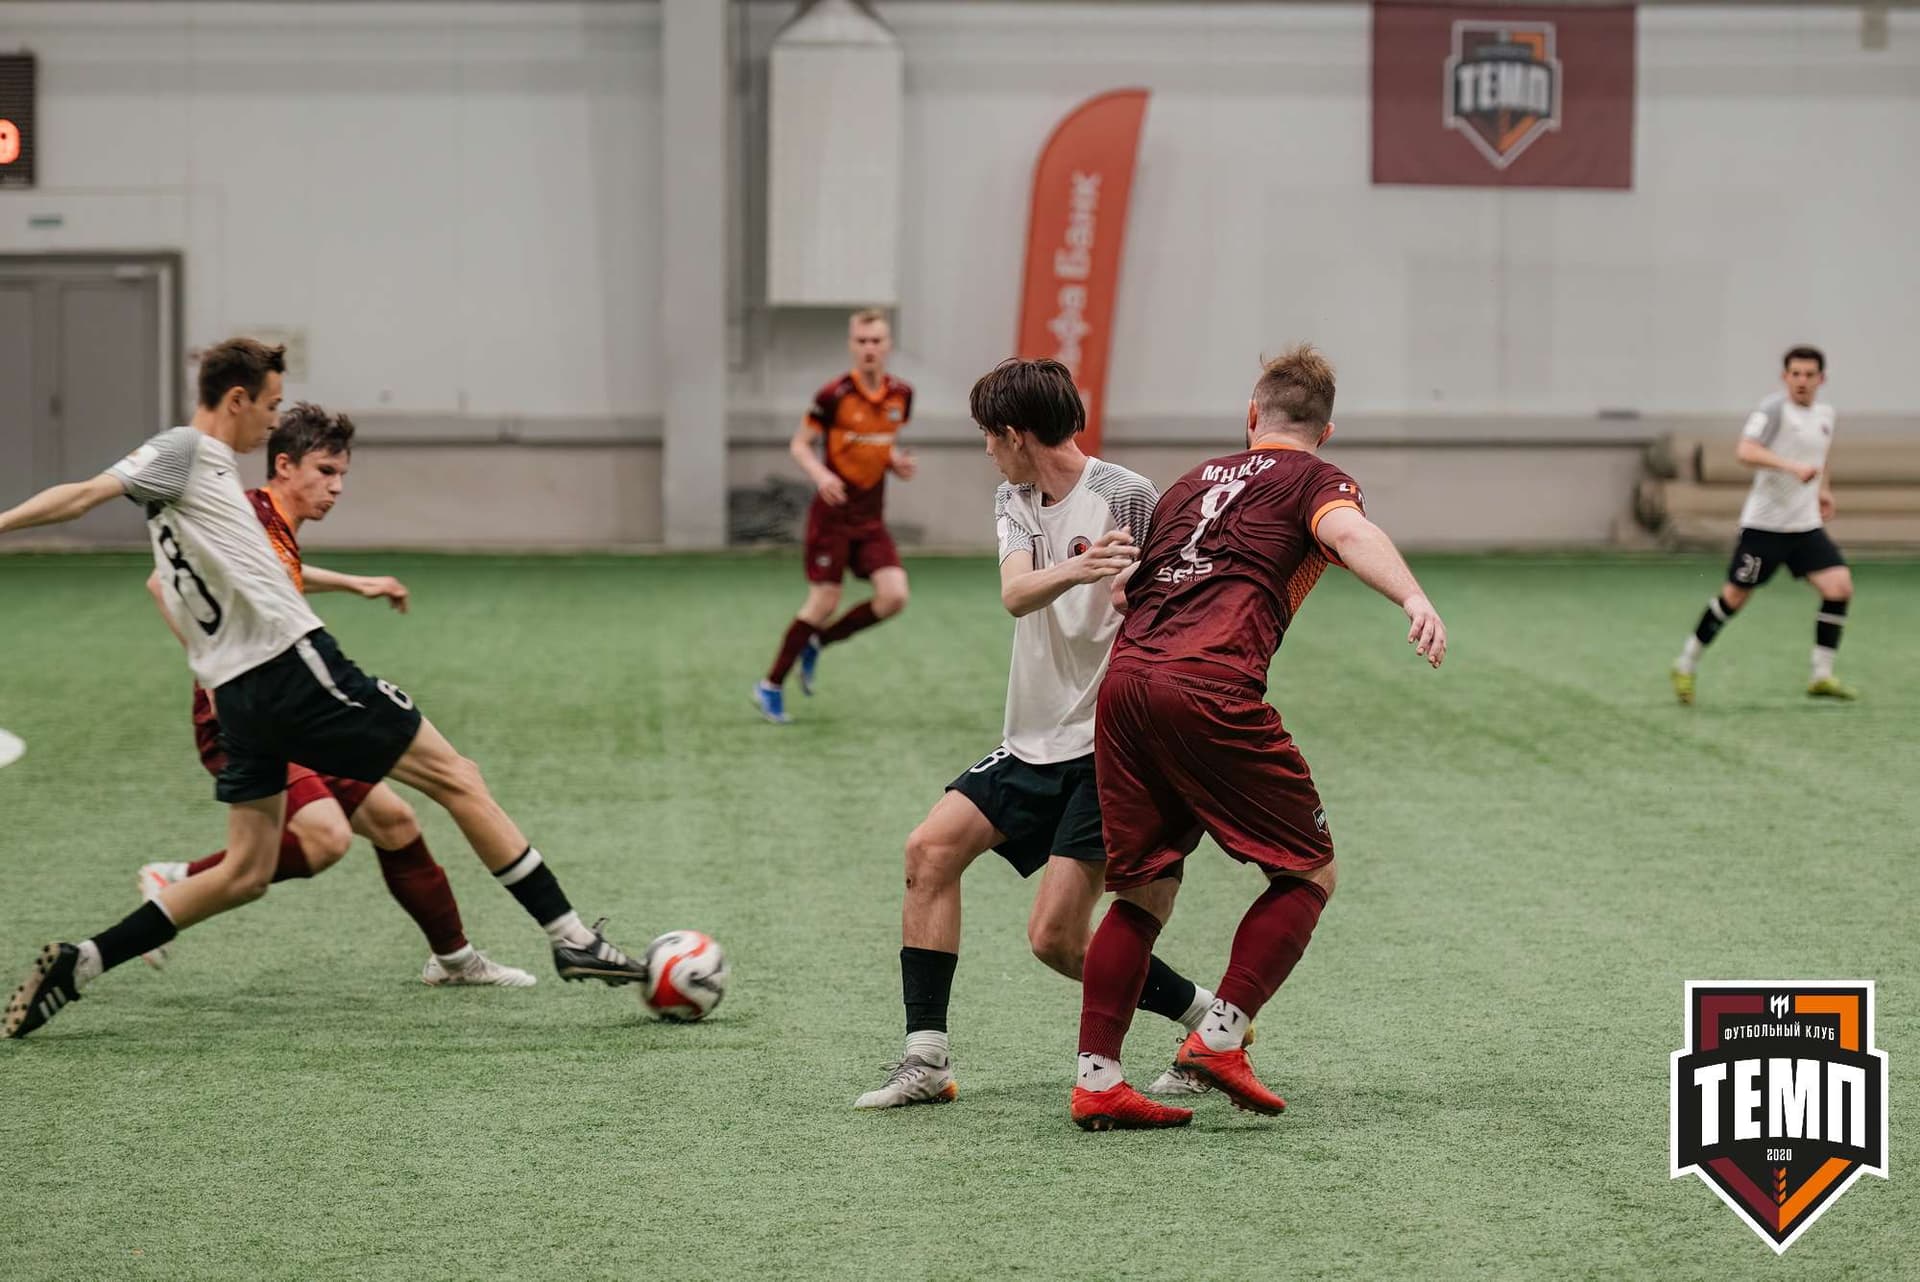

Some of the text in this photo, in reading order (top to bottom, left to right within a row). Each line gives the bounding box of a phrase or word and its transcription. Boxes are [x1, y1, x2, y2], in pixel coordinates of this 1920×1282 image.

[1457, 62, 1550, 114] ТЕМП
[1054, 169, 1103, 281] Банк
[159, 524, 222, 636] 8
